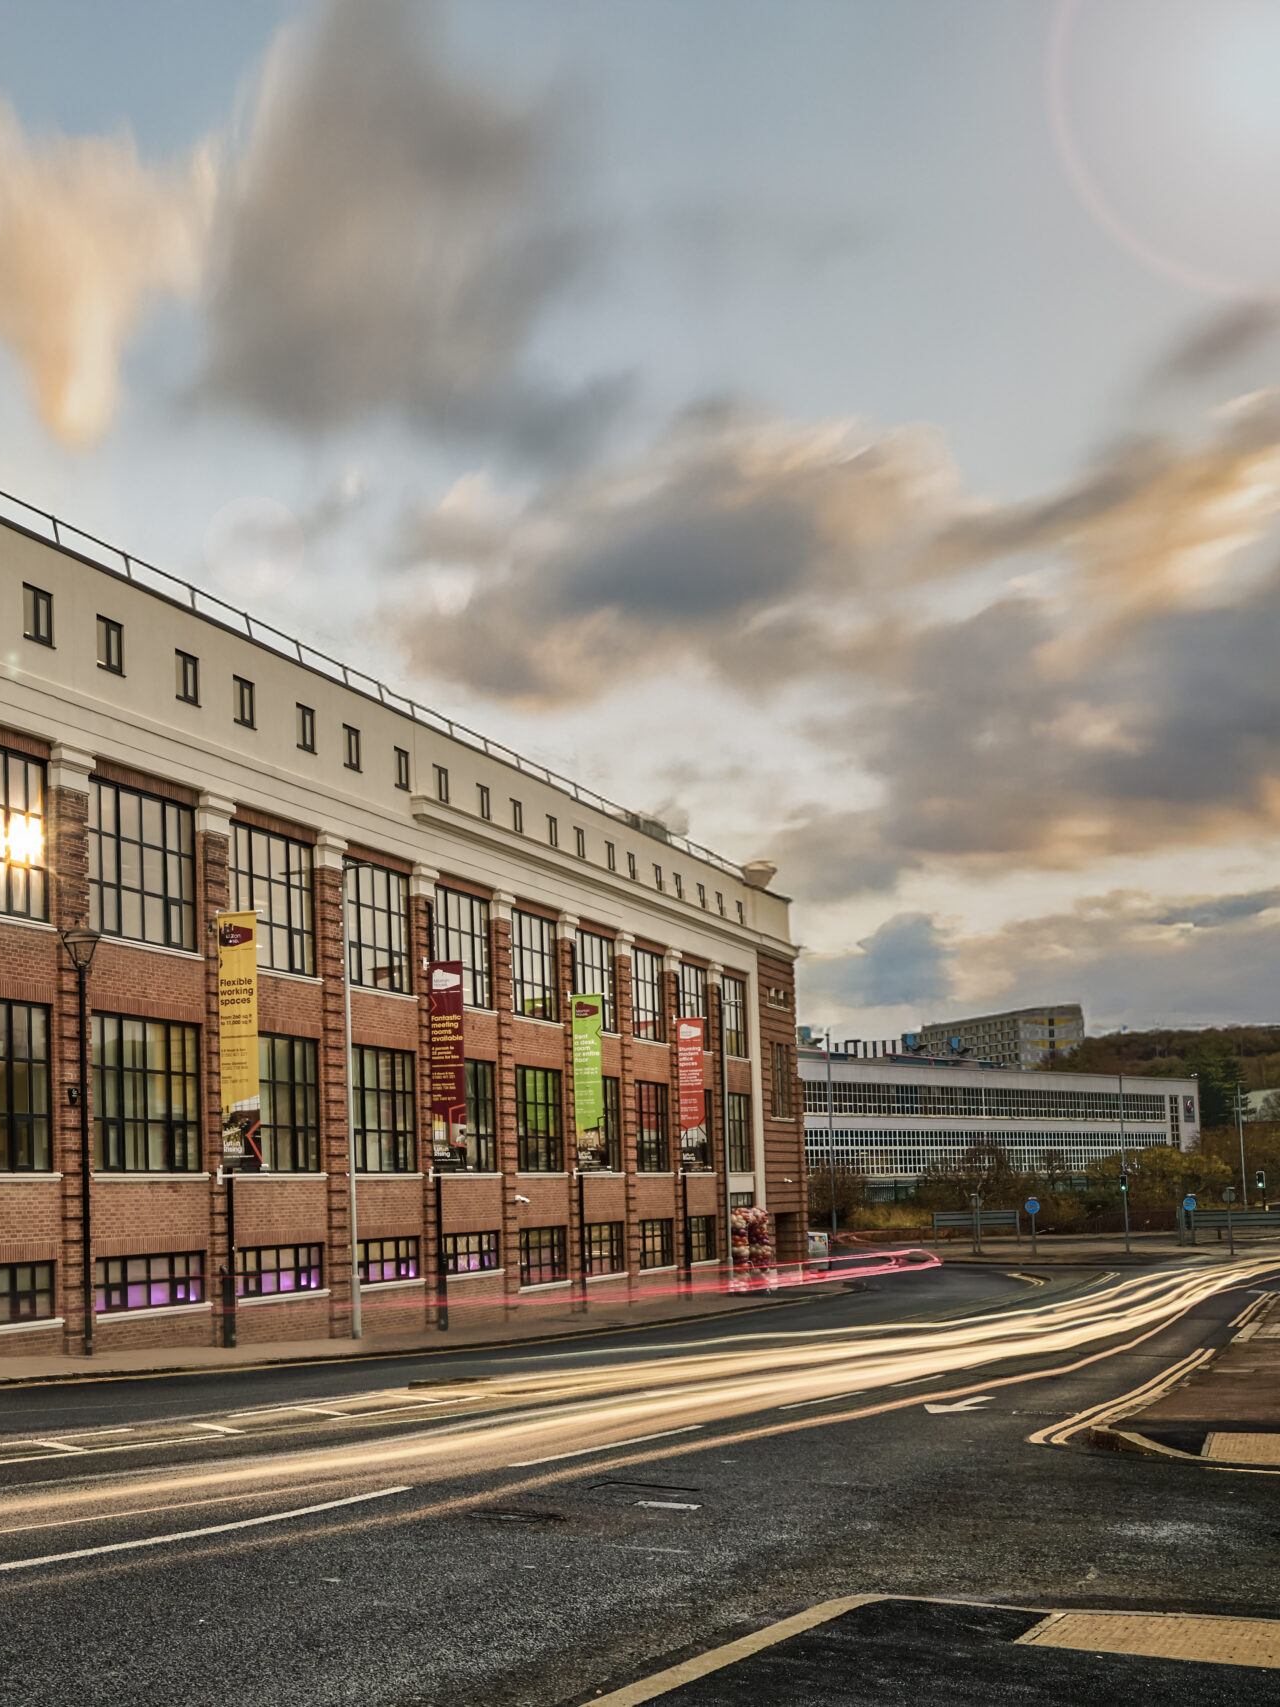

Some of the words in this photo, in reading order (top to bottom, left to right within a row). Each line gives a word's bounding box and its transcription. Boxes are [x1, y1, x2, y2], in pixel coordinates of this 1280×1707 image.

[220, 977, 253, 987] Flexible
[220, 987, 254, 997] working
[220, 997, 251, 1007] spaces
[431, 1014, 462, 1022] Fantastic
[431, 1021, 459, 1029] meeting
[223, 1146, 243, 1154] Rising
